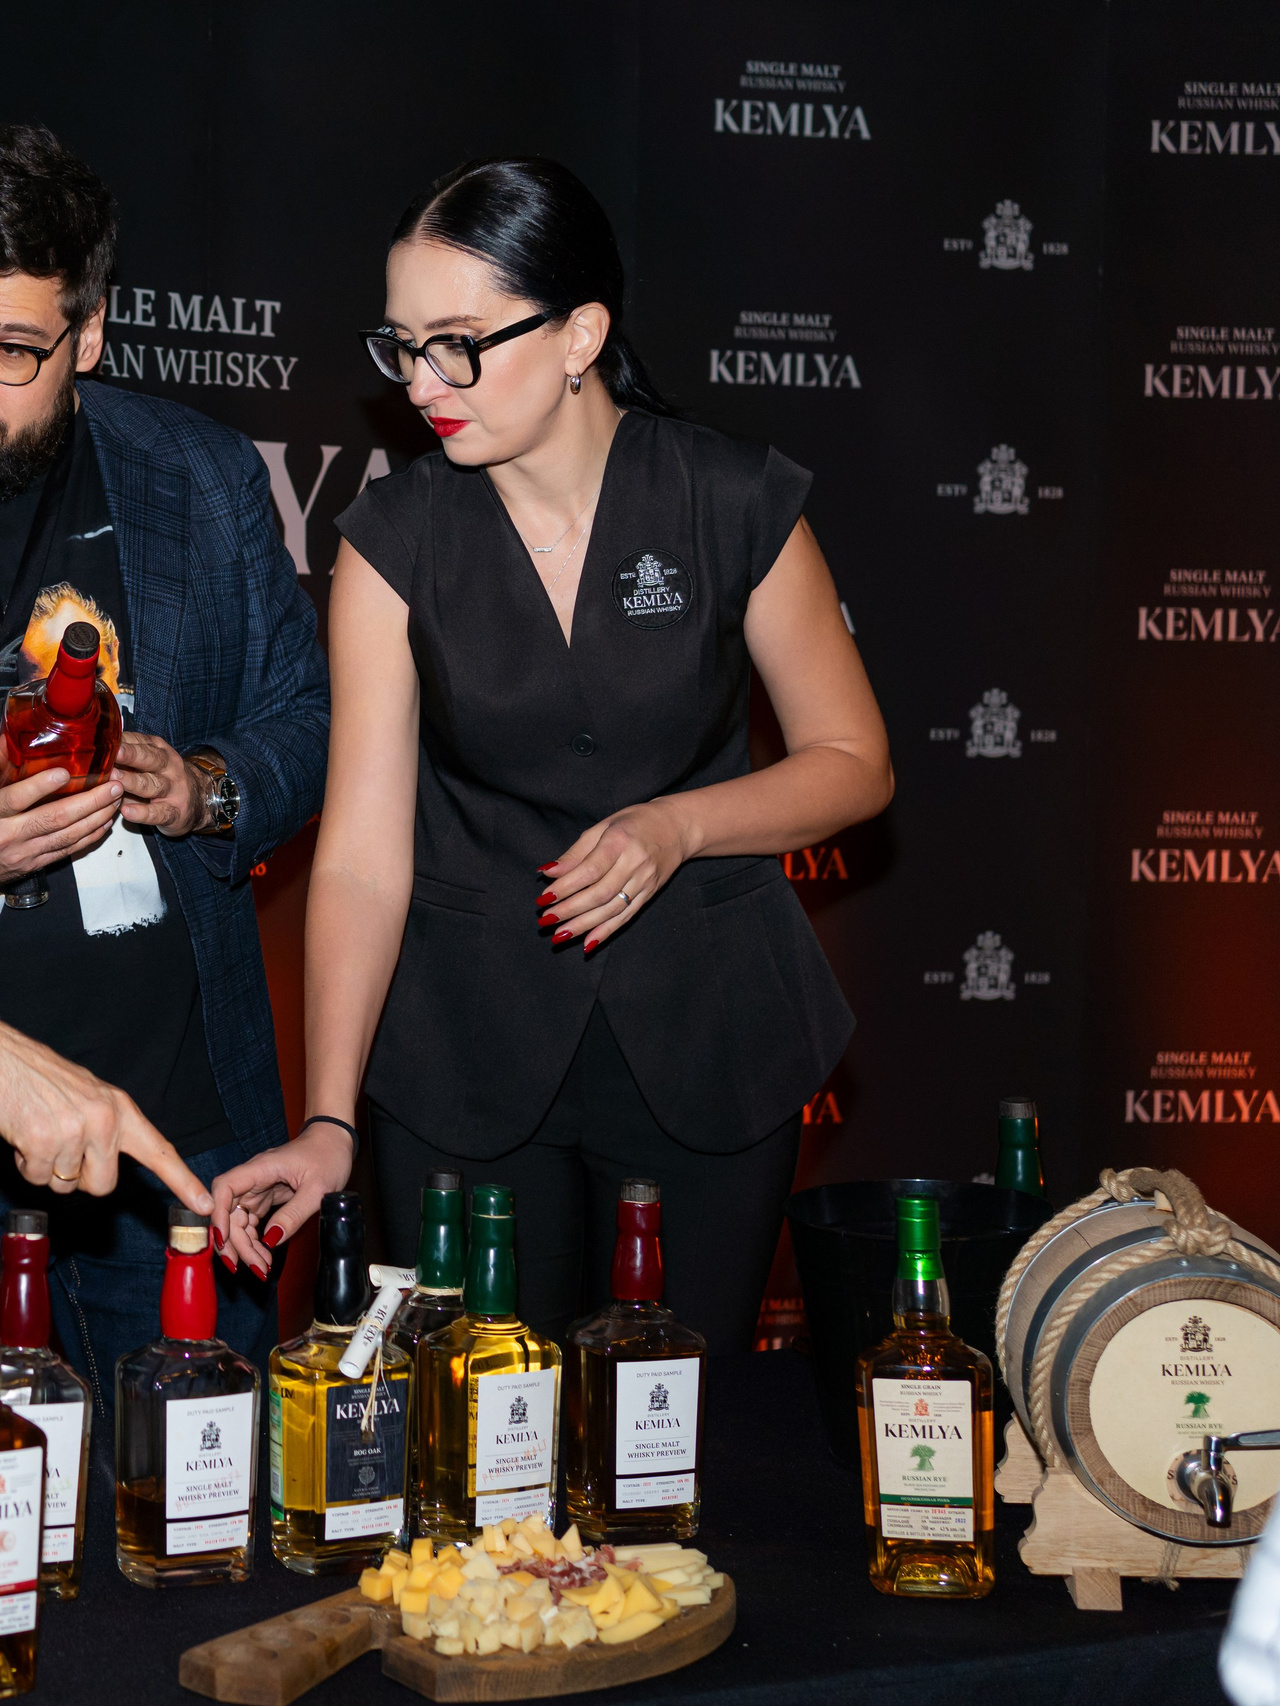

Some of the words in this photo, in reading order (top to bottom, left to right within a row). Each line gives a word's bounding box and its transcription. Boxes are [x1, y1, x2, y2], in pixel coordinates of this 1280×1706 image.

[745, 60, 798, 76] SINGLE
[801, 63, 841, 79] MALT
[740, 74, 793, 90] RUSSIAN
[796, 77, 847, 93] WHISKY
[1184, 81, 1237, 96] SINGLE
[1241, 83, 1280, 97] MALT
[1178, 97, 1233, 110] RUSSIAN
[1236, 98, 1280, 111] WHISK
[714, 98, 872, 141] KEMLYA
[1150, 119, 1280, 155] KEMLY
[167, 291, 282, 338] MALT
[740, 311, 790, 327] SINGLE
[794, 314, 832, 329] MALT
[734, 326, 787, 341] RUSSIAN
[789, 329, 837, 343] WHISKY
[1176, 326, 1230, 340] SINGLE
[1233, 328, 1275, 342] MALT
[1170, 341, 1224, 354] RUSSIAN
[154, 346, 299, 391] WHISKY
[709, 349, 862, 389] KEMLYA
[1143, 364, 1280, 400] KEMLY
[1170, 569, 1221, 584] SINGLE
[1224, 570, 1266, 585] MALT
[633, 586, 670, 596] DISTILLERY
[1163, 583, 1218, 597] RUSSIAN
[1220, 584, 1271, 599] WHISKY
[623, 592, 683, 609] KEMLYA
[628, 607, 656, 617] RUSSIAN
[657, 605, 682, 614] WHISKY
[1162, 810, 1213, 825] SINGLE
[1217, 811, 1259, 826] MALT
[1157, 825, 1210, 839] RUSSIAN
[1211, 826, 1263, 840] WHISKY
[784, 847, 849, 880] LYA
[1130, 848, 1280, 883] KEMLYA
[1156, 1052, 1208, 1066] SINGLE
[1211, 1052, 1251, 1066] MALT
[1124, 1089, 1280, 1124] KEMLYA
[1161, 1364, 1232, 1377] KEMLYA
[635, 1418, 681, 1431] KEMLYA
[884, 1423, 962, 1440] KEMLYA
[496, 1431, 539, 1445] KEMLYA
[635, 1442, 660, 1450] SINGLE
[496, 1457, 519, 1465] SINGLE
[521, 1454, 538, 1462] MALT
[628, 1451, 655, 1459] WHISKY
[656, 1449, 687, 1457] PREVIEW
[186, 1457, 233, 1472] KEMLYA
[488, 1465, 515, 1474] WHISKY
[516, 1462, 544, 1471] PREVIEW
[186, 1483, 212, 1492] SINGLE
[214, 1481, 233, 1489] MALT
[178, 1493, 207, 1502] WHISKY
[209, 1489, 240, 1499] PREVIEW
